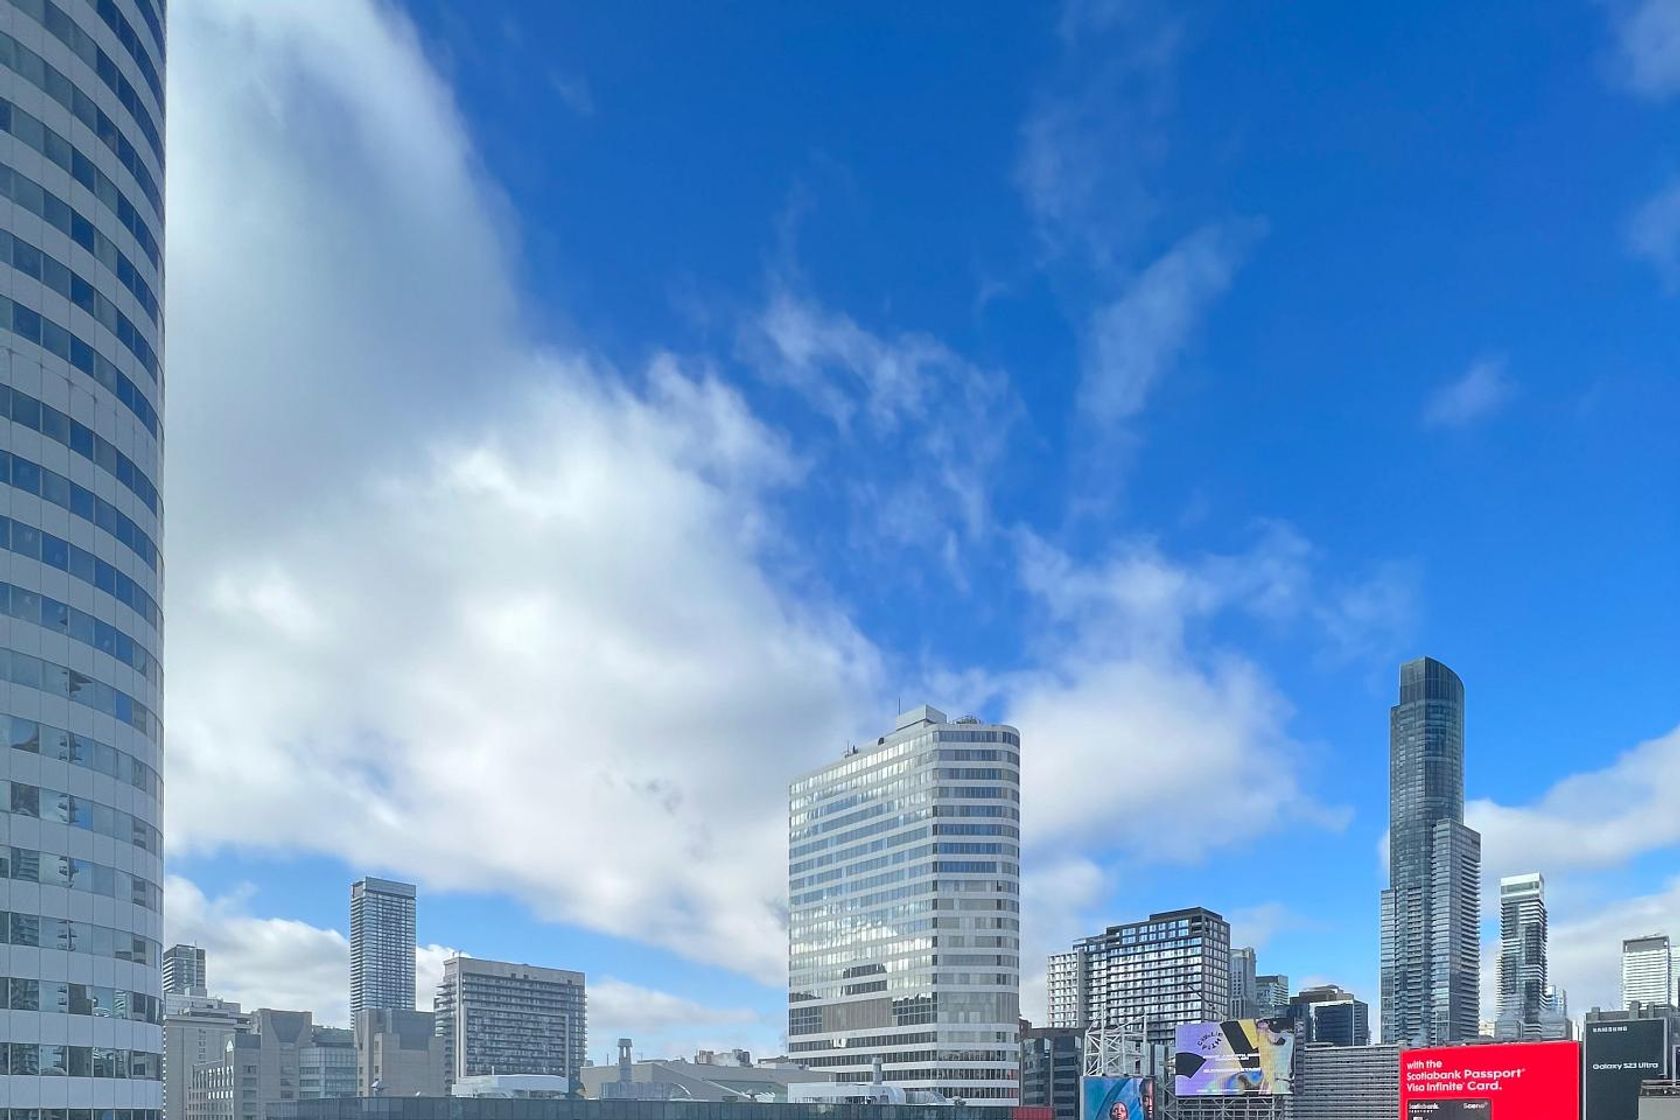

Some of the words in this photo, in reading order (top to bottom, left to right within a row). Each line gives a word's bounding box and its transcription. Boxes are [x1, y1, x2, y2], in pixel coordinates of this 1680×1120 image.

[1406, 1061, 1425, 1070] with
[1426, 1060, 1442, 1068] the
[1406, 1070, 1461, 1081] Scotiabank
[1464, 1068, 1521, 1080] Passport
[1406, 1083, 1425, 1092] Visa
[1426, 1082, 1463, 1092] Infinite
[1467, 1081, 1502, 1091] Card.
